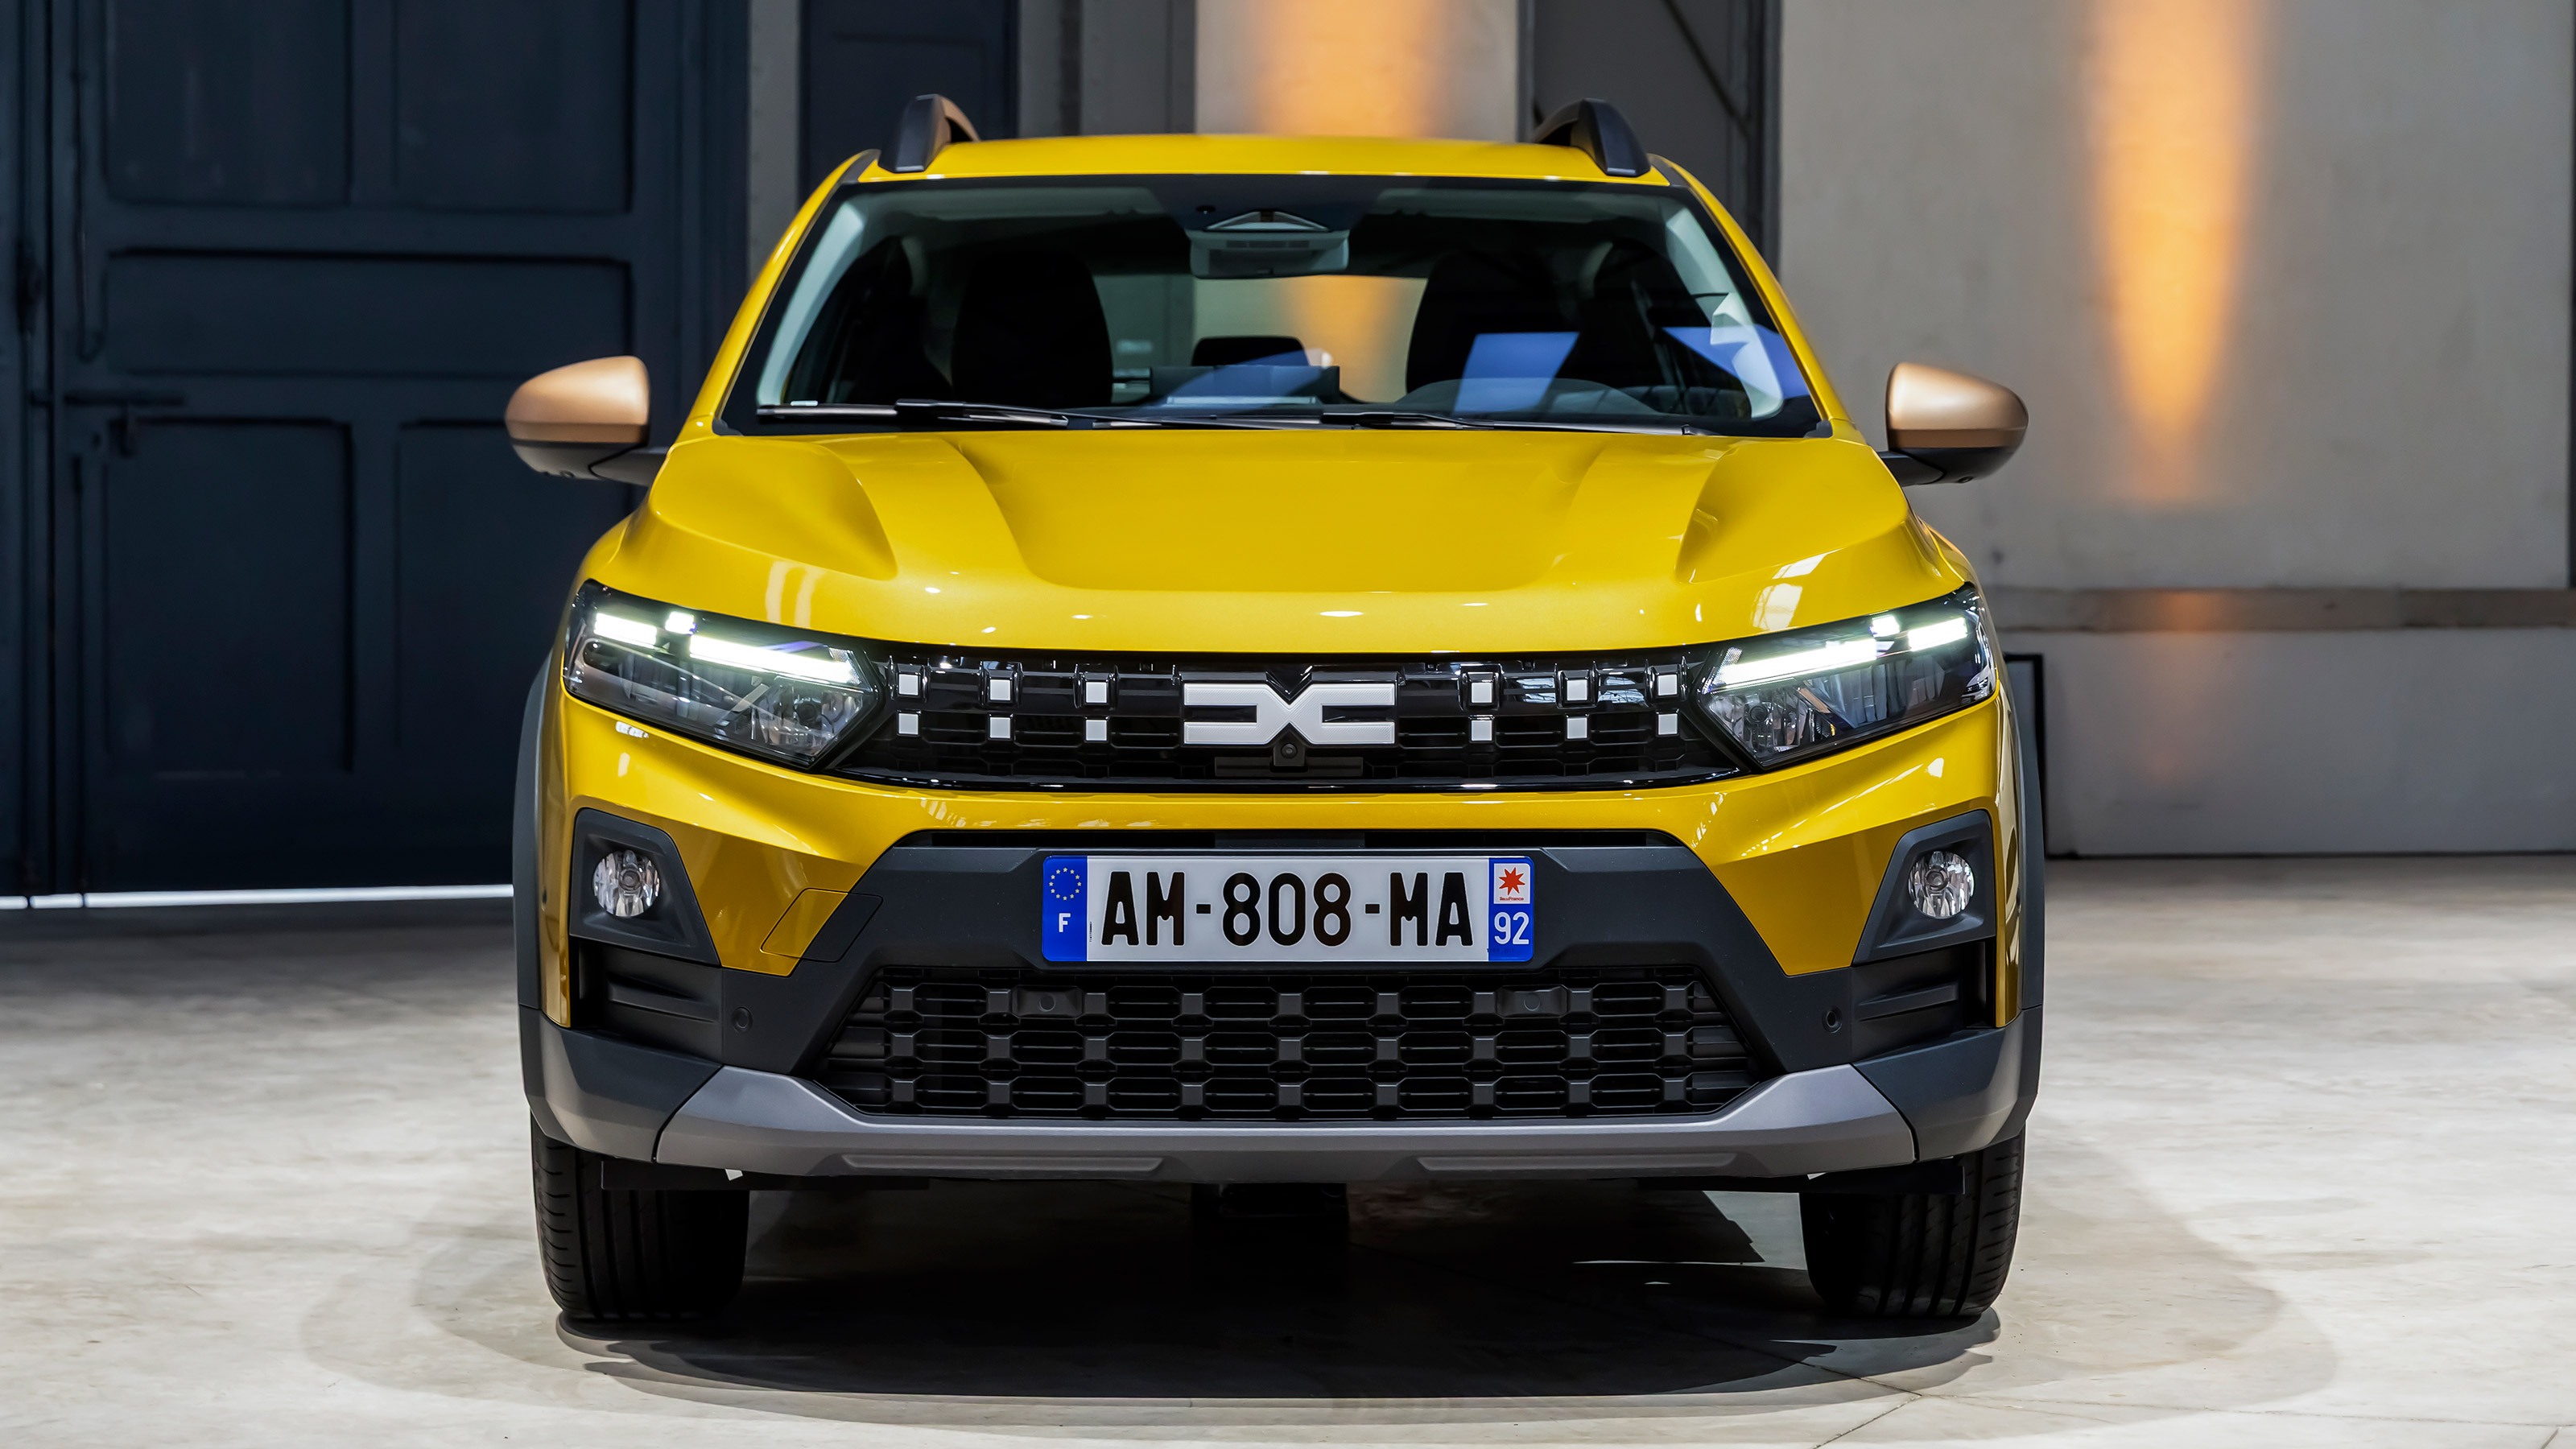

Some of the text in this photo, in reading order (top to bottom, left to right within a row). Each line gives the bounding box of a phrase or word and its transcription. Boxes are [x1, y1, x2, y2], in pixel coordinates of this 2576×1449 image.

[1059, 912, 1071, 933] F
[1100, 871, 1474, 947] AM-808-MA
[1494, 911, 1530, 945] 92
